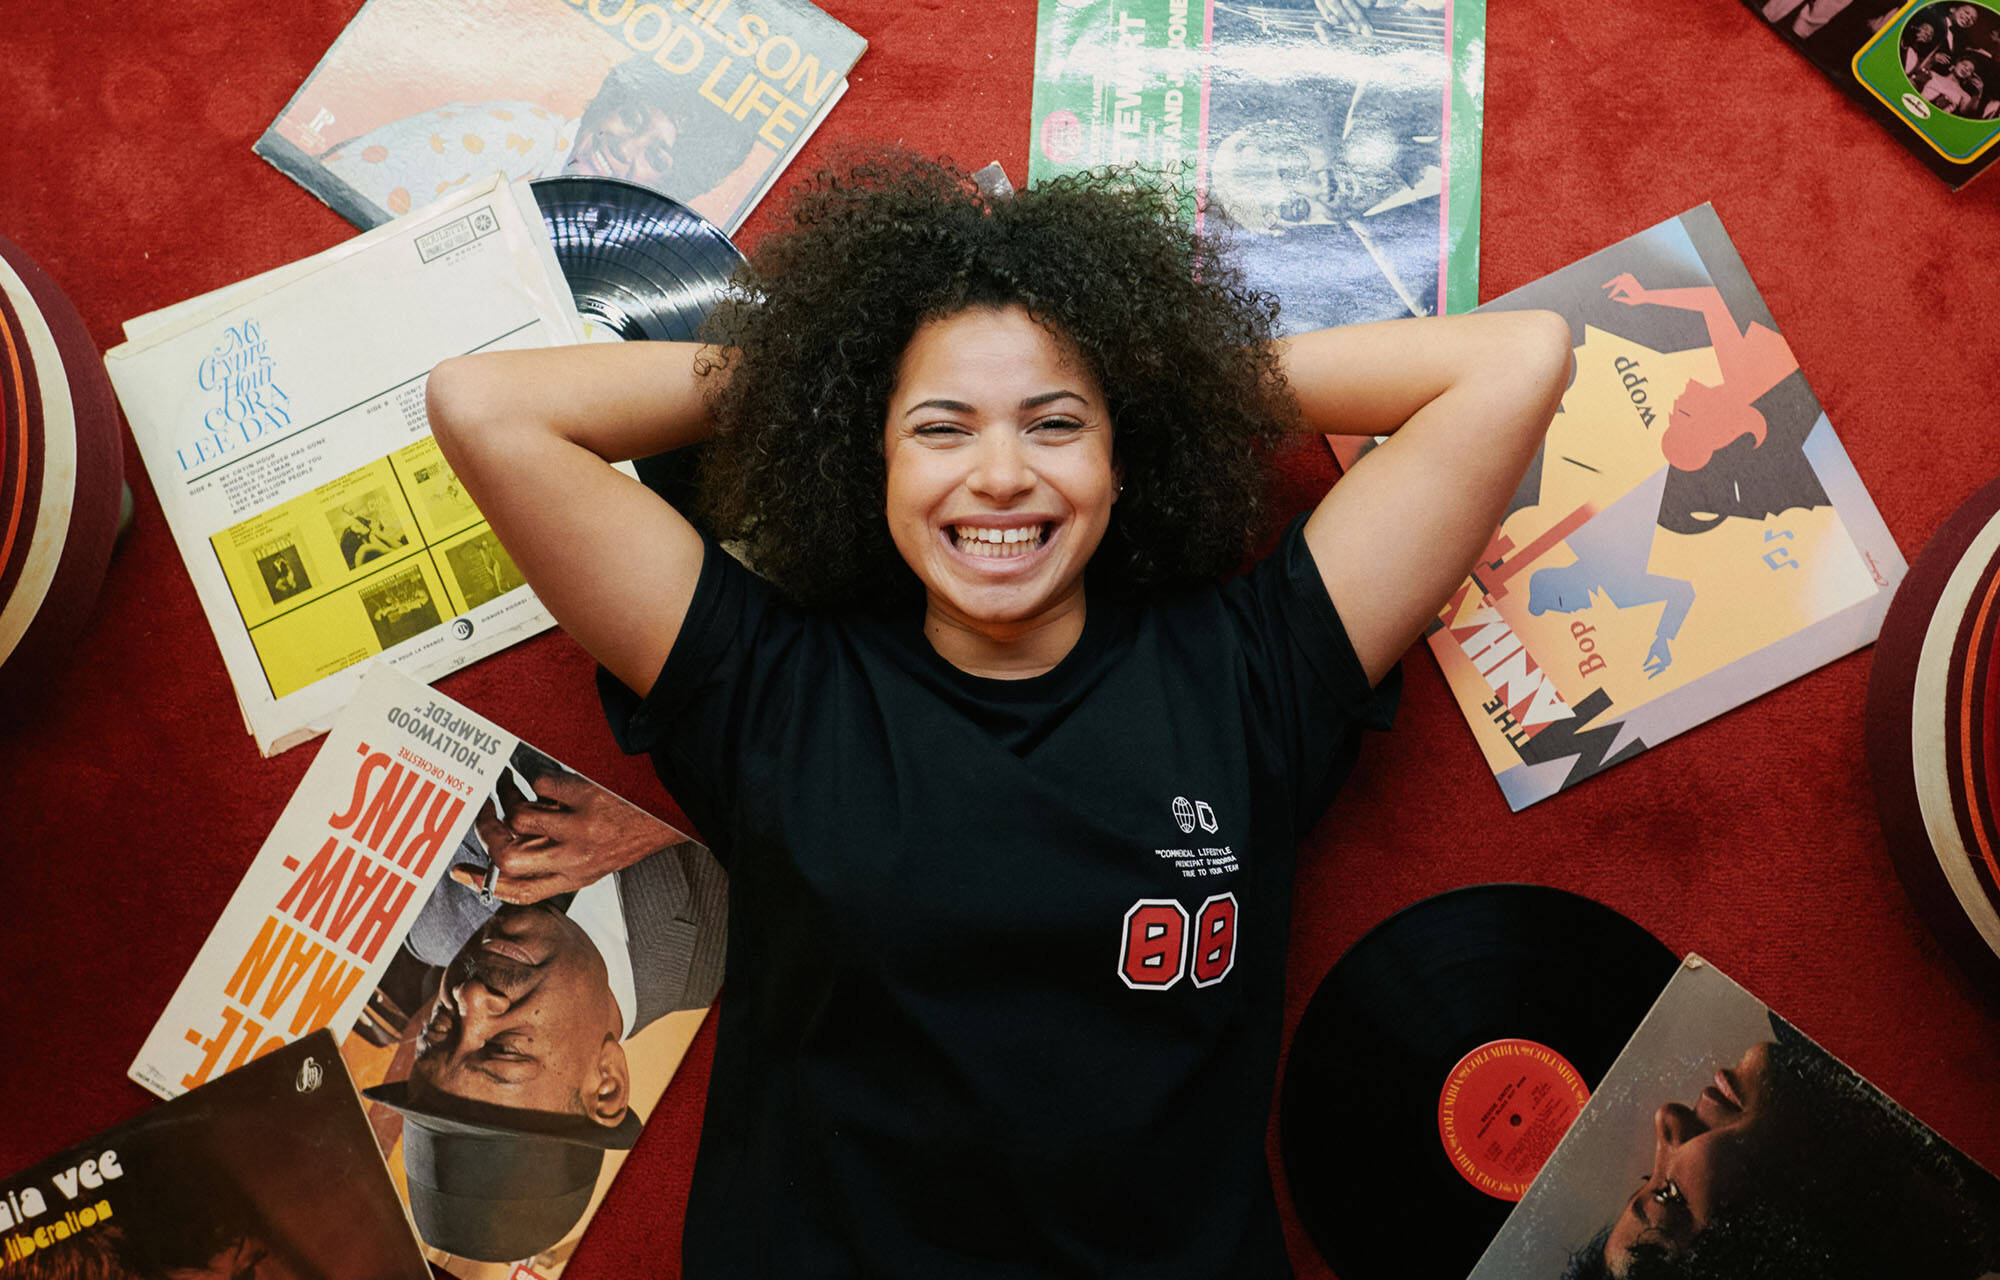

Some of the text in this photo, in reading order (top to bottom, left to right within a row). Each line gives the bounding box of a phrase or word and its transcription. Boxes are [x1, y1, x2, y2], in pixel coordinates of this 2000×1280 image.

[566, 0, 809, 150] OOD LIFE
[214, 317, 263, 358] My
[203, 383, 290, 433] CORA
[1613, 355, 1657, 430] wopp
[176, 409, 295, 471] LEE DAY
[221, 438, 326, 488] WHEN YOUR LOVER HAS GONE
[218, 473, 230, 482] MY
[256, 453, 275, 465] HOUR
[224, 477, 255, 494] TROUBLE
[273, 461, 290, 472] MAN
[227, 491, 241, 500] THE
[243, 482, 260, 493] VERY
[262, 467, 294, 485] THOUGHT
[307, 454, 322, 464] YOU
[257, 479, 286, 495] MILLION
[287, 466, 313, 481] PEOPLE
[1570, 620, 1607, 679] Bop
[1483, 694, 1531, 749] THE
[397, 745, 474, 797] & SON ORCHESTRE
[329, 742, 466, 879] KINS.
[1175, 859, 1204, 868] PRINCIPAT
[1182, 864, 1239, 878] TRUE TO YOUR TEAM
[1198, 845, 1232, 857] LIFESTYLE
[276, 835, 417, 964] HAW-
[224, 915, 366, 1036] MAN
[181, 1005, 287, 1090] LE-
[1464, 1044, 1521, 1077] COLUMBIA
[1528, 1045, 1578, 1092] COLUMBIA
[1443, 1078, 1464, 1139] COLUMBIA
[52, 1149, 124, 1200] vee
[1456, 1146, 1503, 1192] COLUMBIA
[5, 1199, 113, 1262] liberation
